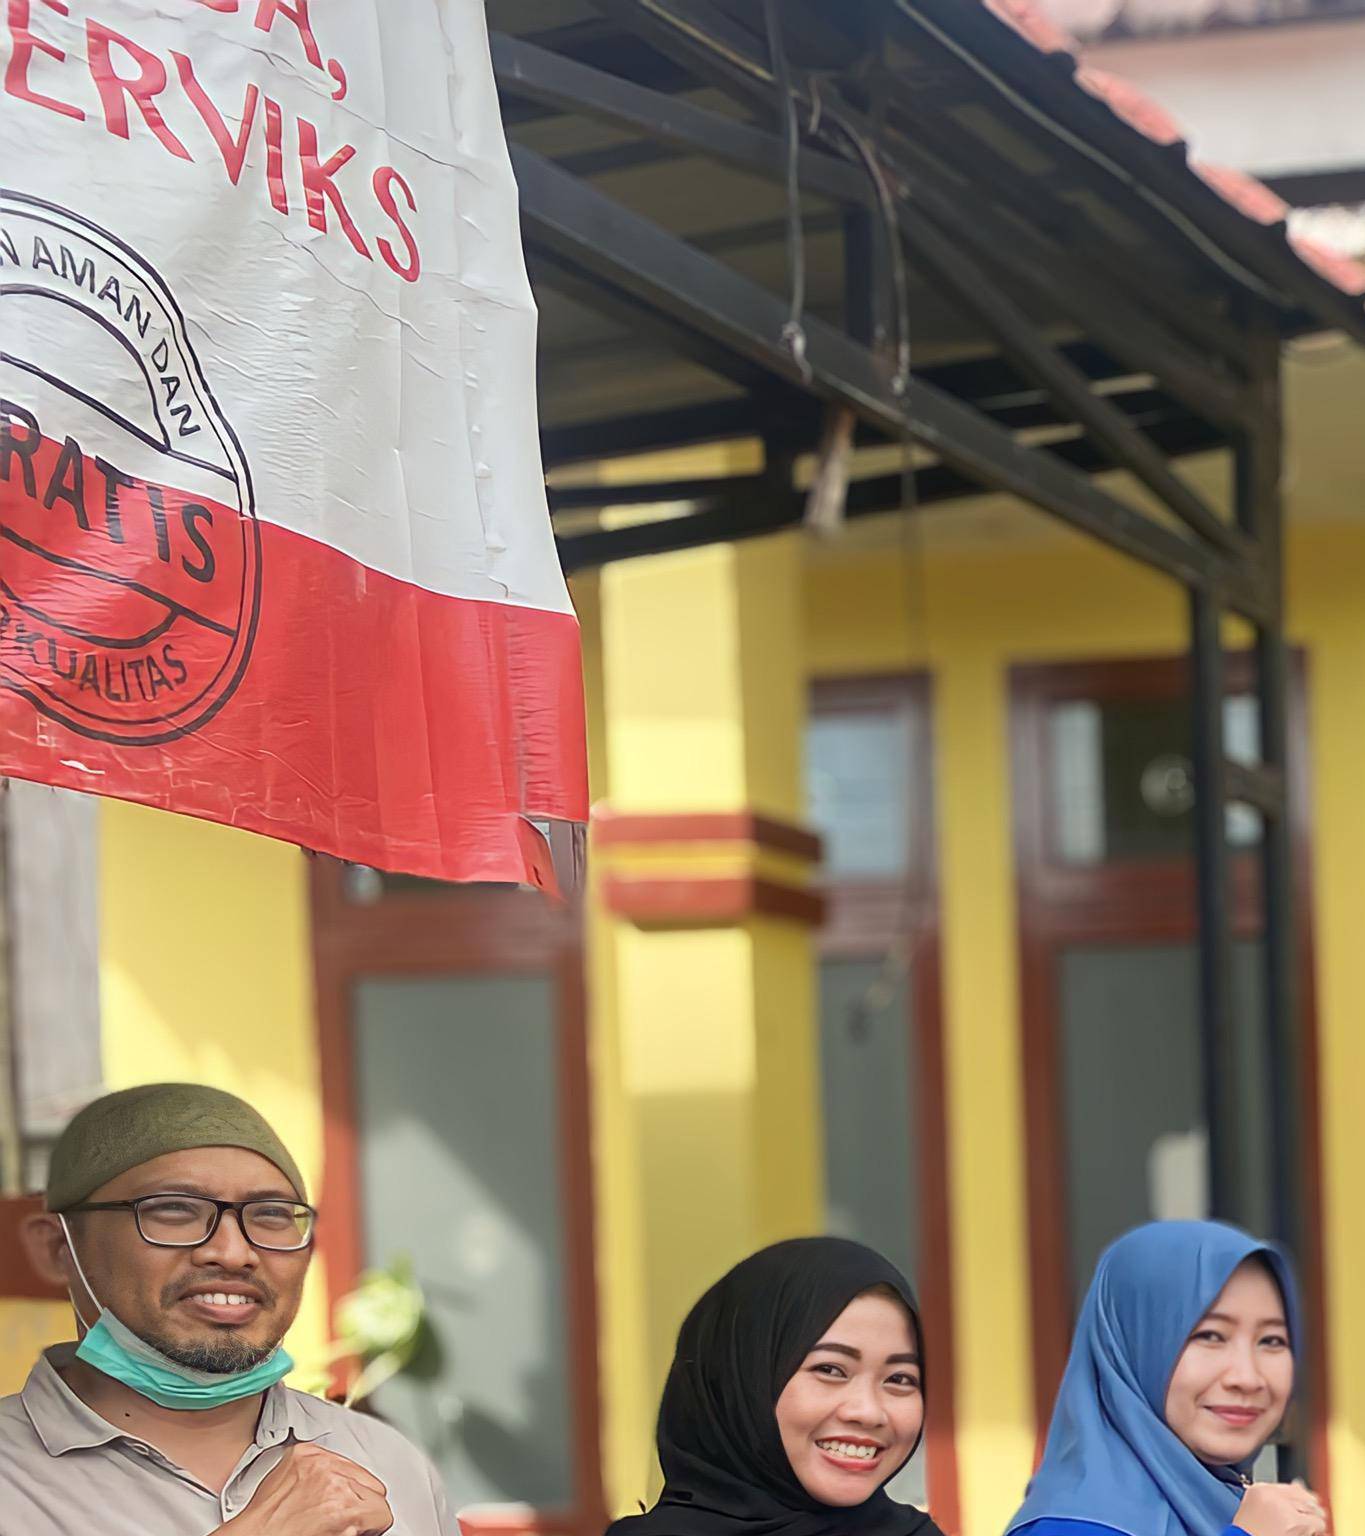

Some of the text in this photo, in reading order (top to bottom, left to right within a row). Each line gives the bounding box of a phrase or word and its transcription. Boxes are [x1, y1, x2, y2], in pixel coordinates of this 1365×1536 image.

[5, 0, 421, 283] ERVIKS
[32, 235, 151, 339] AMAN
[151, 337, 201, 436] DAN
[0, 398, 216, 583] RATIS
